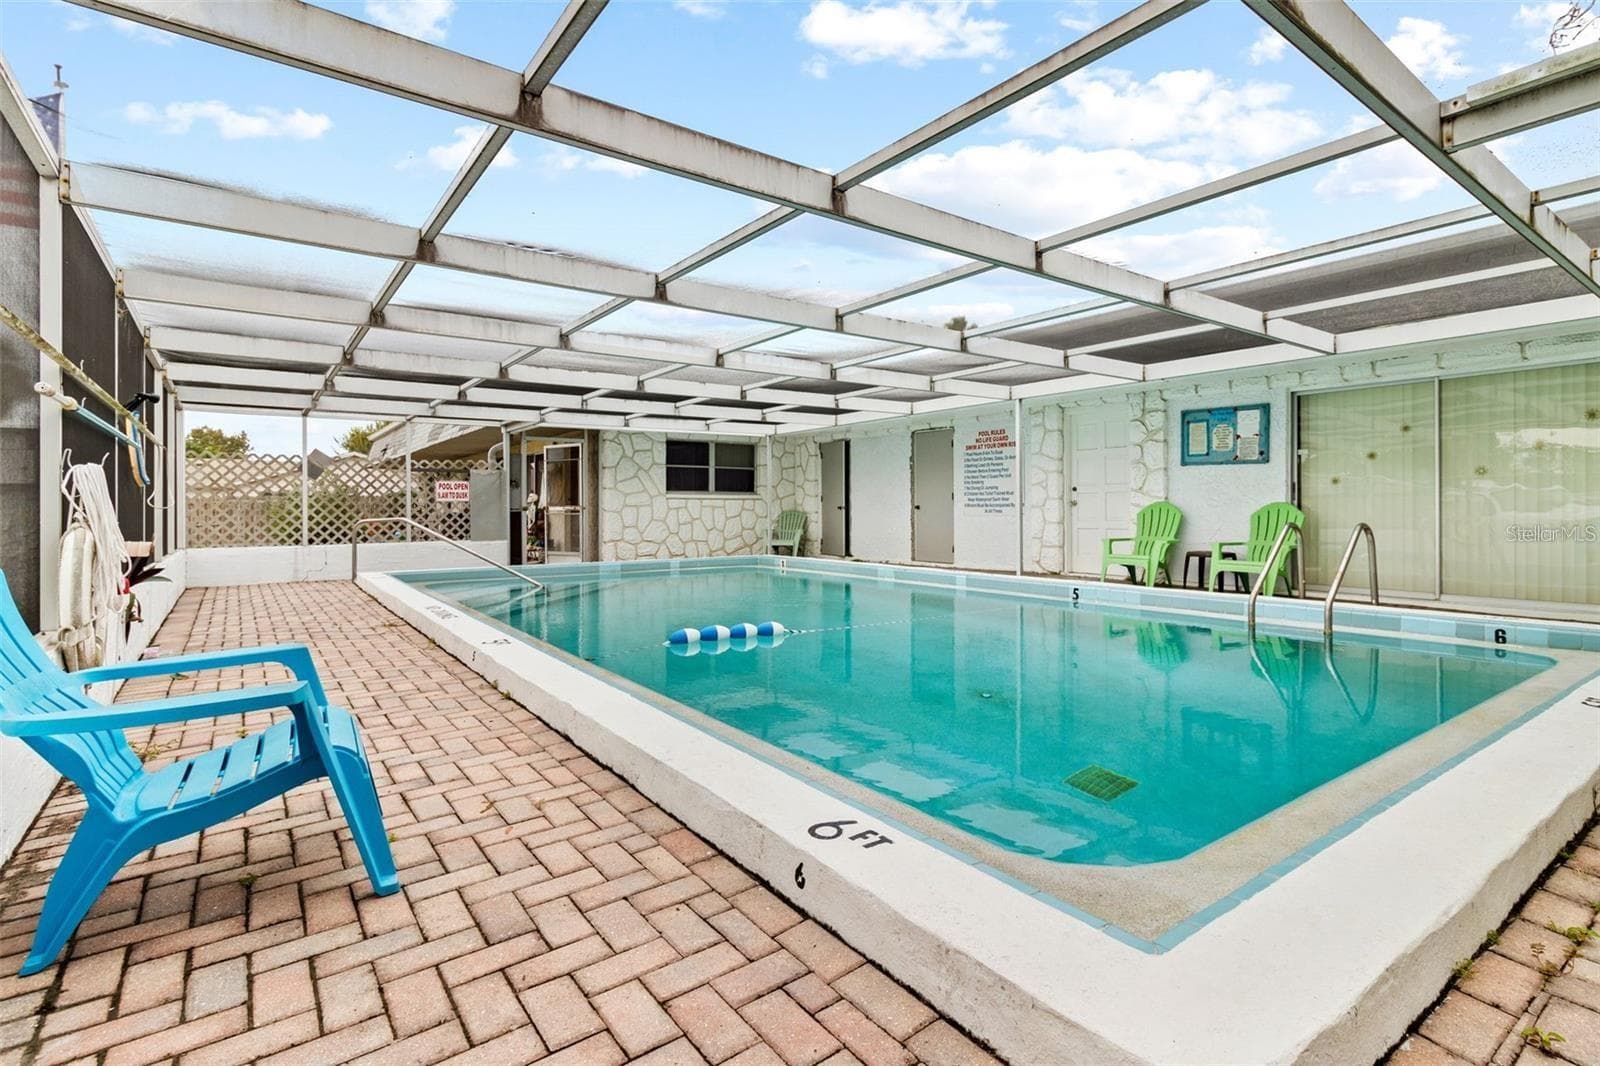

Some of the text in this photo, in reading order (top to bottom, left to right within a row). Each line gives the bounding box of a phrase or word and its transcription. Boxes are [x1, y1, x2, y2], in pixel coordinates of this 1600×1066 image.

[997, 441, 1008, 449] OWN
[1072, 588, 1079, 600] 5
[1494, 629, 1507, 644] 6
[807, 820, 894, 848] 6 FT
[795, 862, 806, 889] 6
